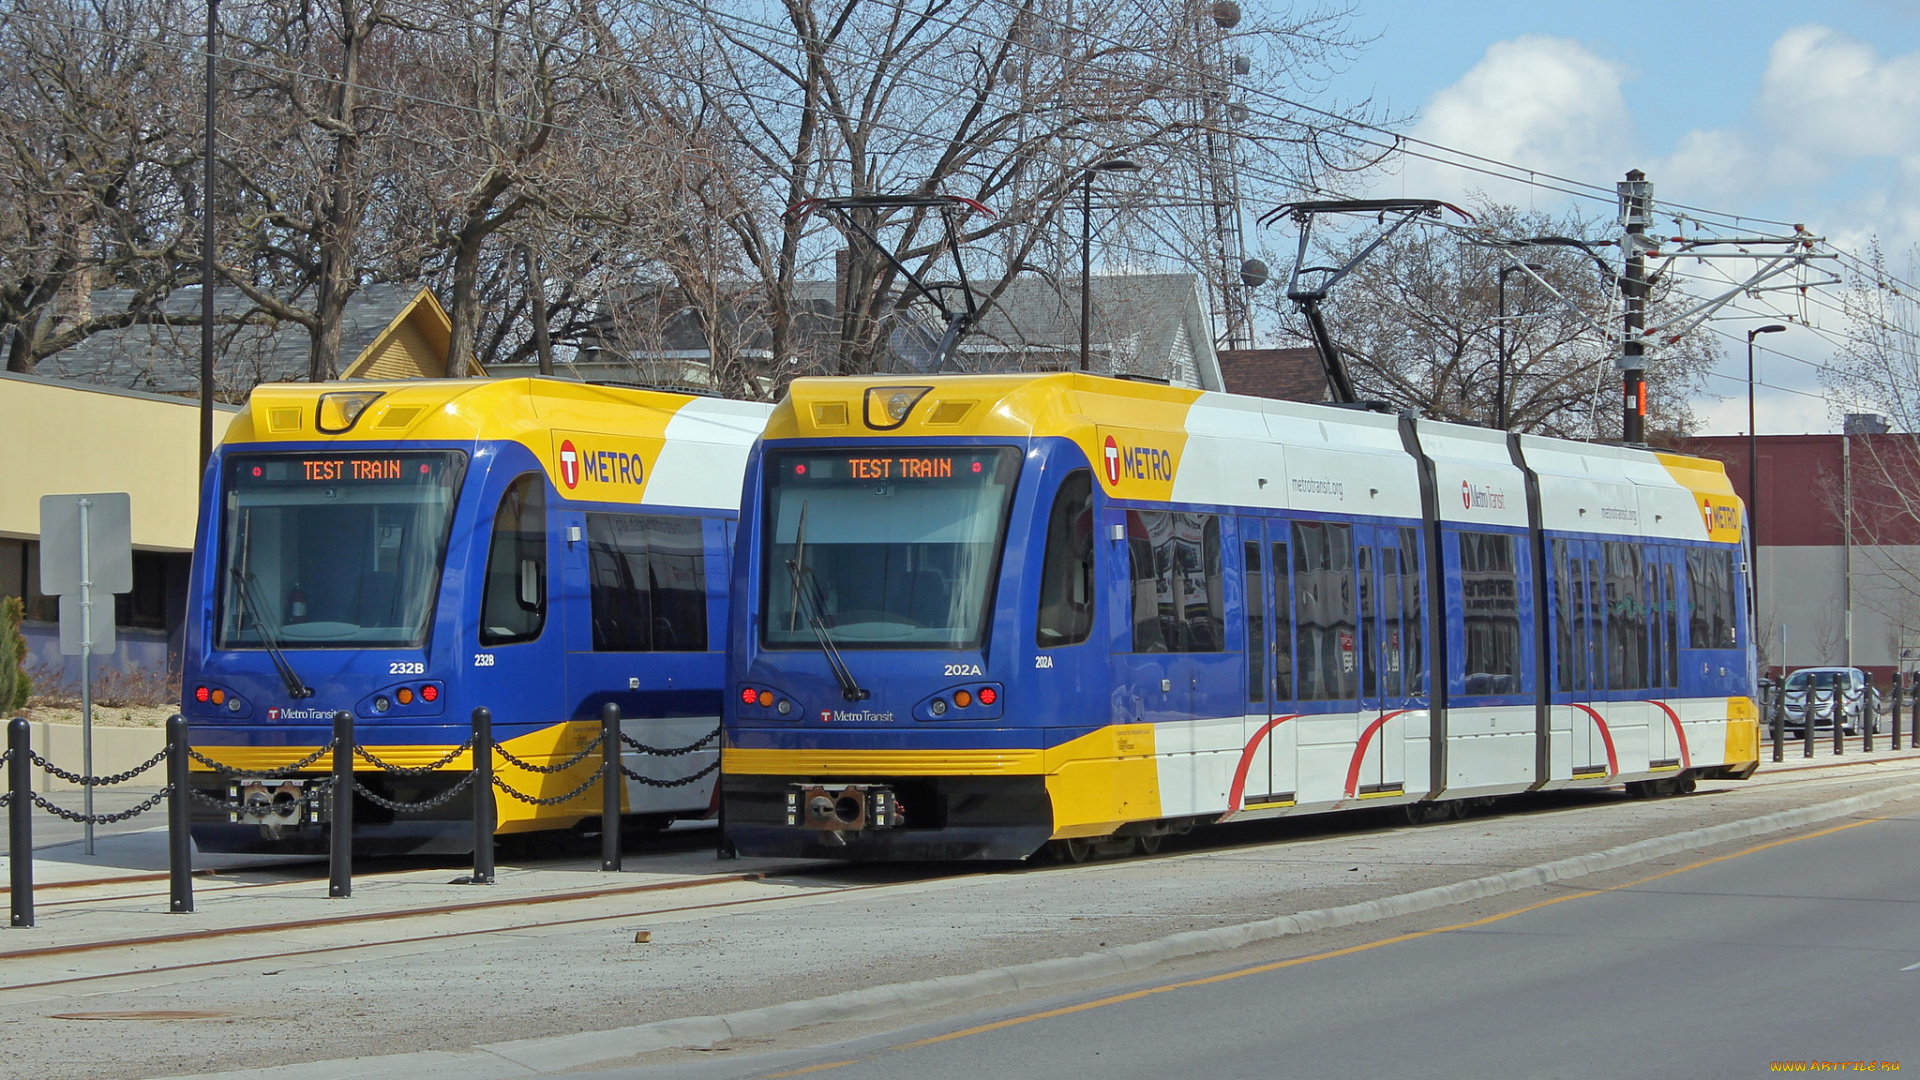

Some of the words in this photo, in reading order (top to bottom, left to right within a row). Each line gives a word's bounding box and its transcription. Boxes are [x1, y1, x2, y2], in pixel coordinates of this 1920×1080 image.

[303, 461, 344, 480] TEST
[351, 460, 401, 479] TRAIN
[583, 450, 644, 485] METRO
[849, 459, 892, 478] TEST
[899, 458, 951, 477] TRAIN
[1123, 445, 1172, 482] METRO
[1291, 476, 1344, 501] metrotransit.org
[1713, 506, 1738, 530] METRO
[389, 663, 425, 675] 232B
[474, 654, 495, 667] 232B
[944, 664, 982, 676] 202A
[1035, 655, 1054, 669] 202A
